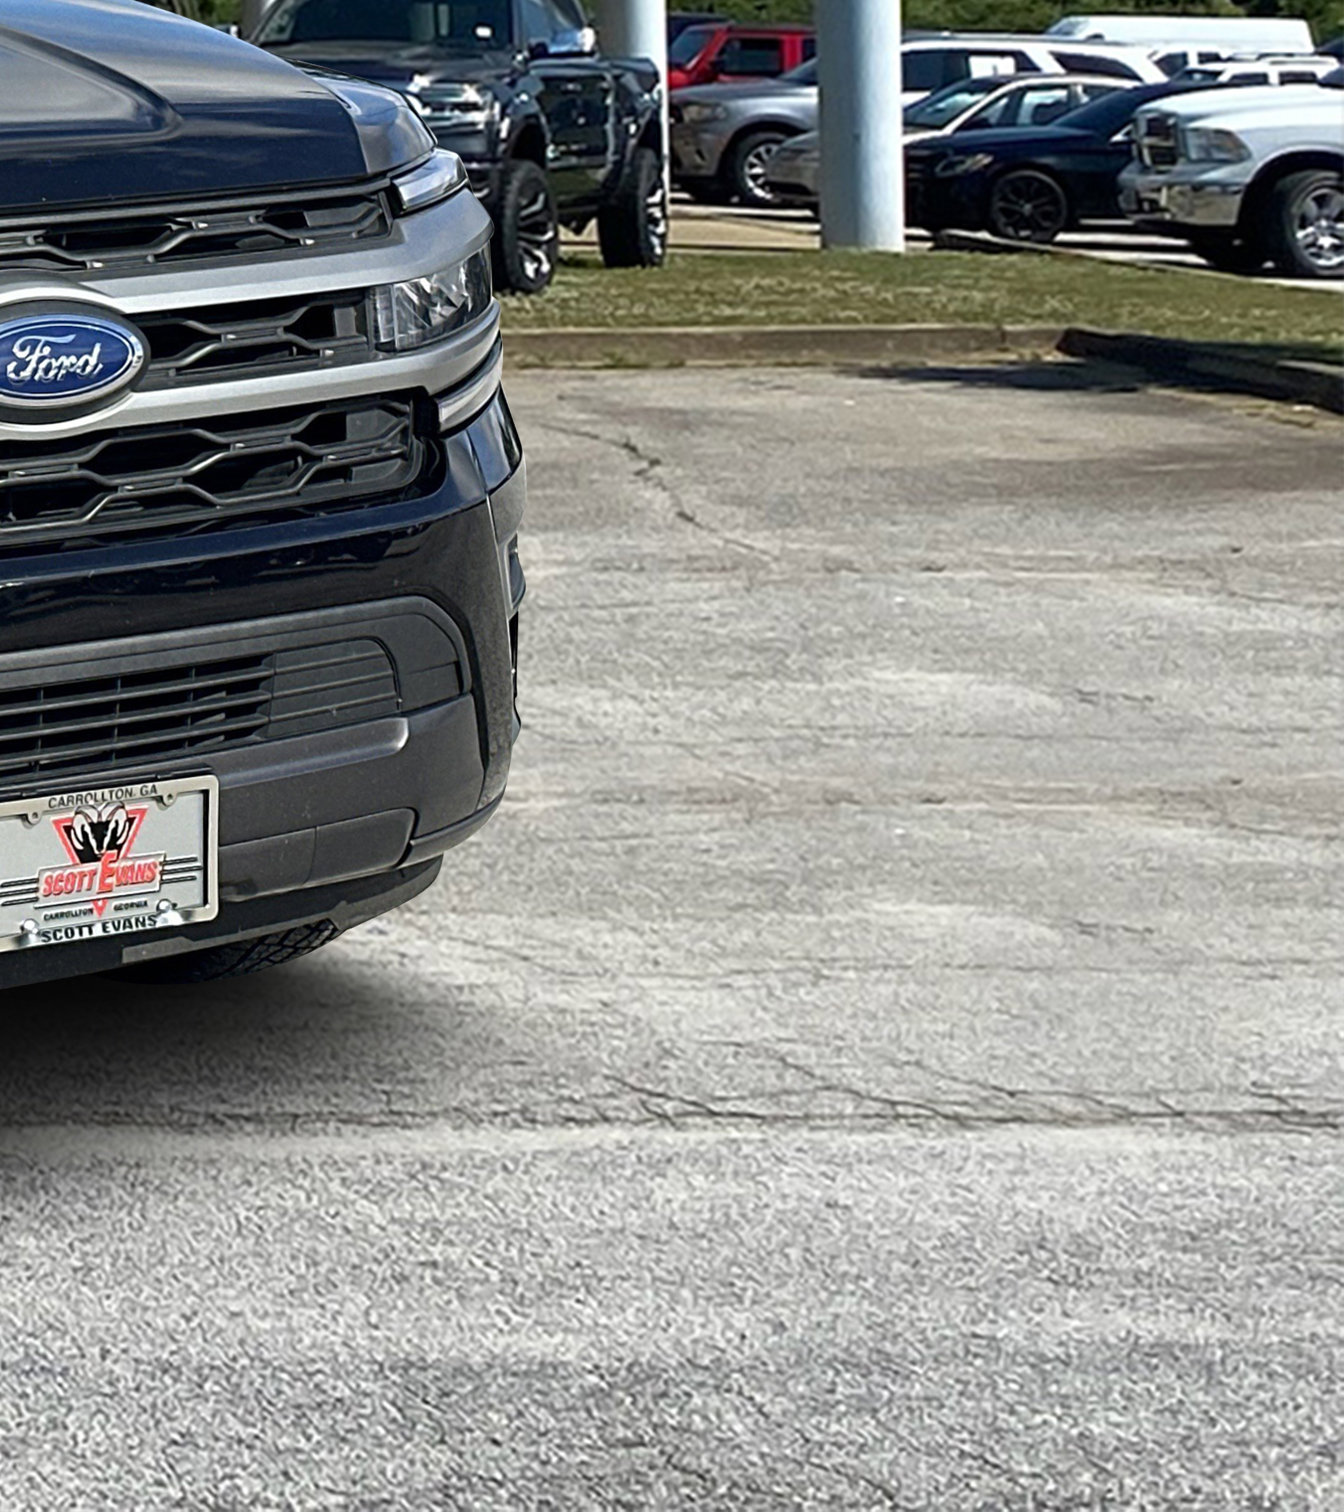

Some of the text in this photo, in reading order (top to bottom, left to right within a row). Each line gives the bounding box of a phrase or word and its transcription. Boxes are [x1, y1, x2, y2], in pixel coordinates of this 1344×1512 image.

[6, 333, 105, 383] Ford
[138, 783, 159, 797] GA
[42, 849, 159, 897] SCOTT EVANS
[40, 914, 158, 944] SCOTT EVANS
